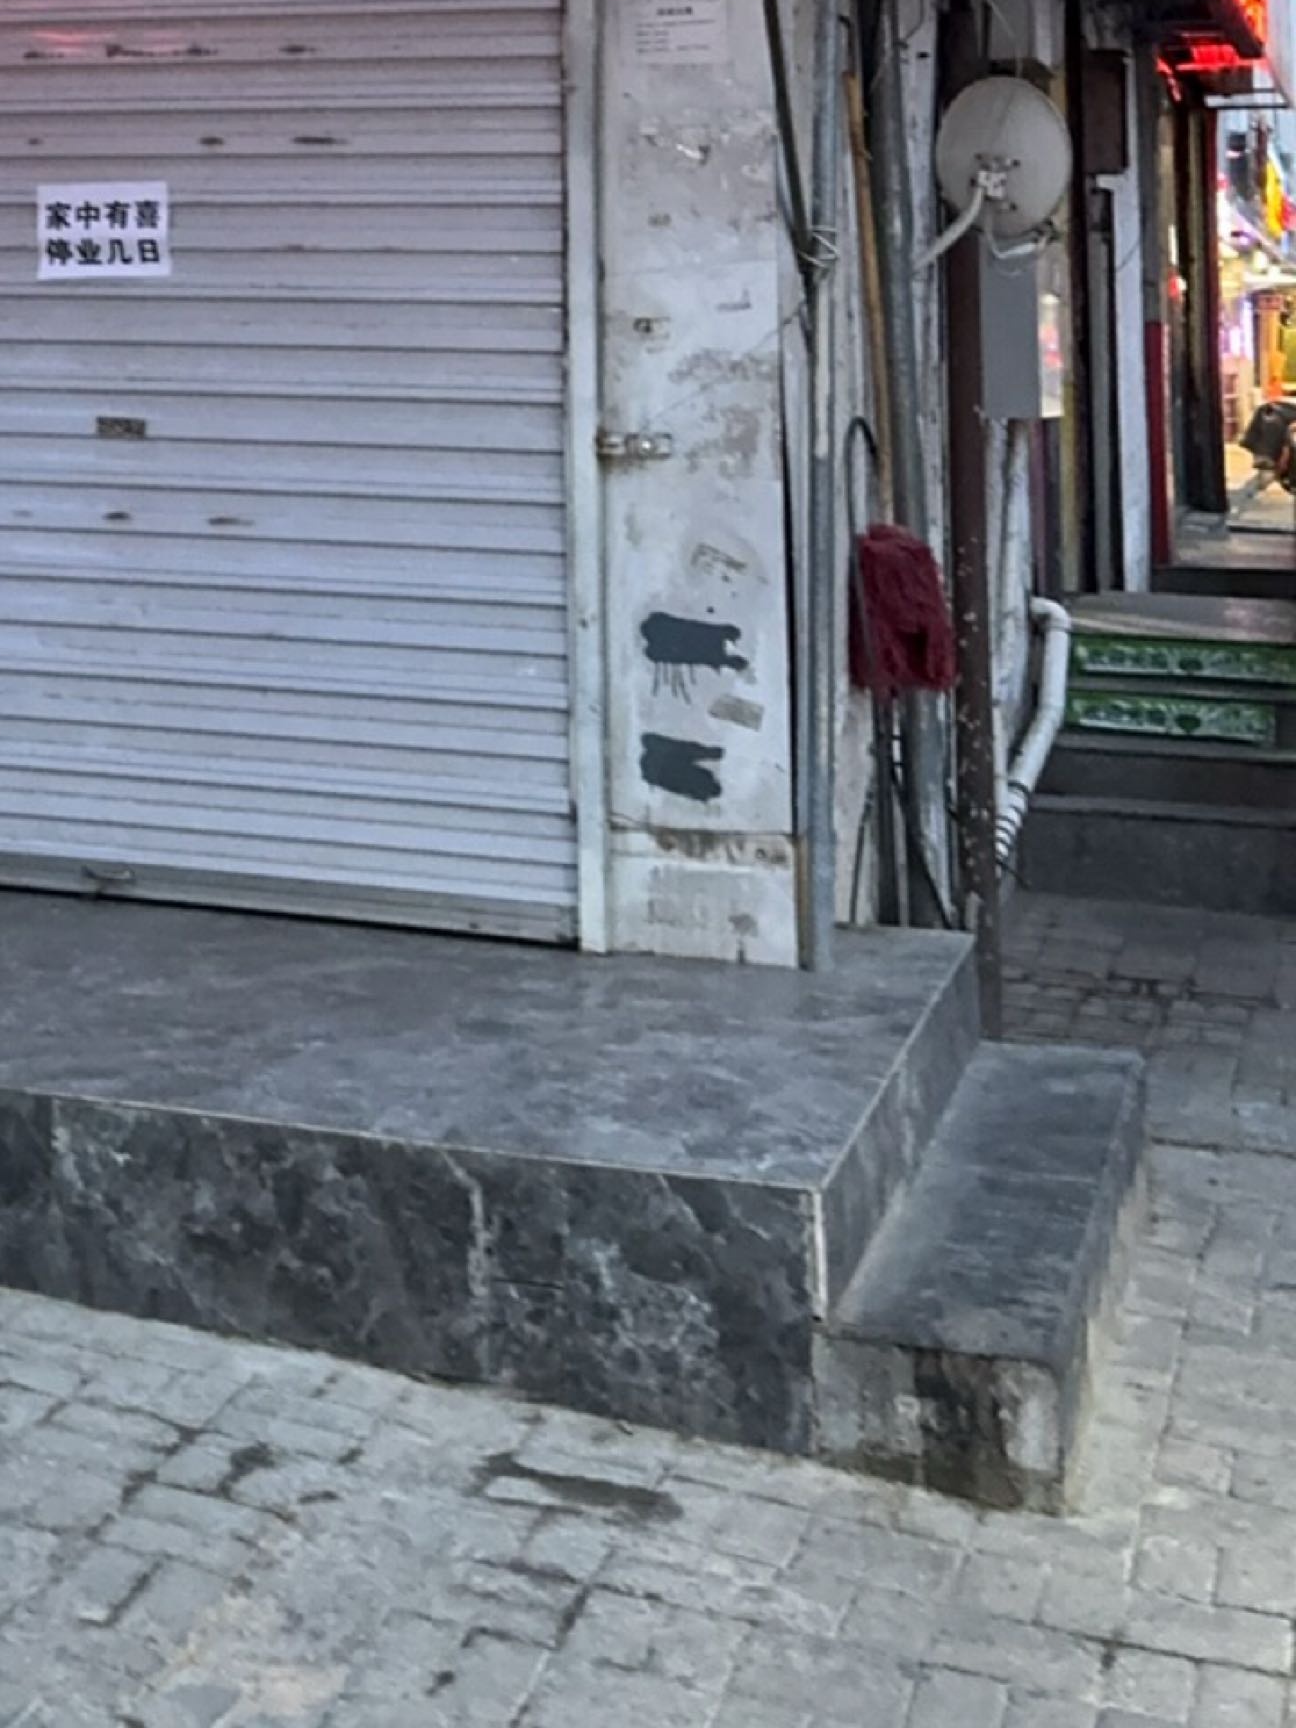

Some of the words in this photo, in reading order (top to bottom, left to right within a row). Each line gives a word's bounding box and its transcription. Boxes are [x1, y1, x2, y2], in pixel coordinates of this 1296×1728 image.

[45, 200, 161, 230] 家中有喜
[45, 237, 161, 265] 停业几日
